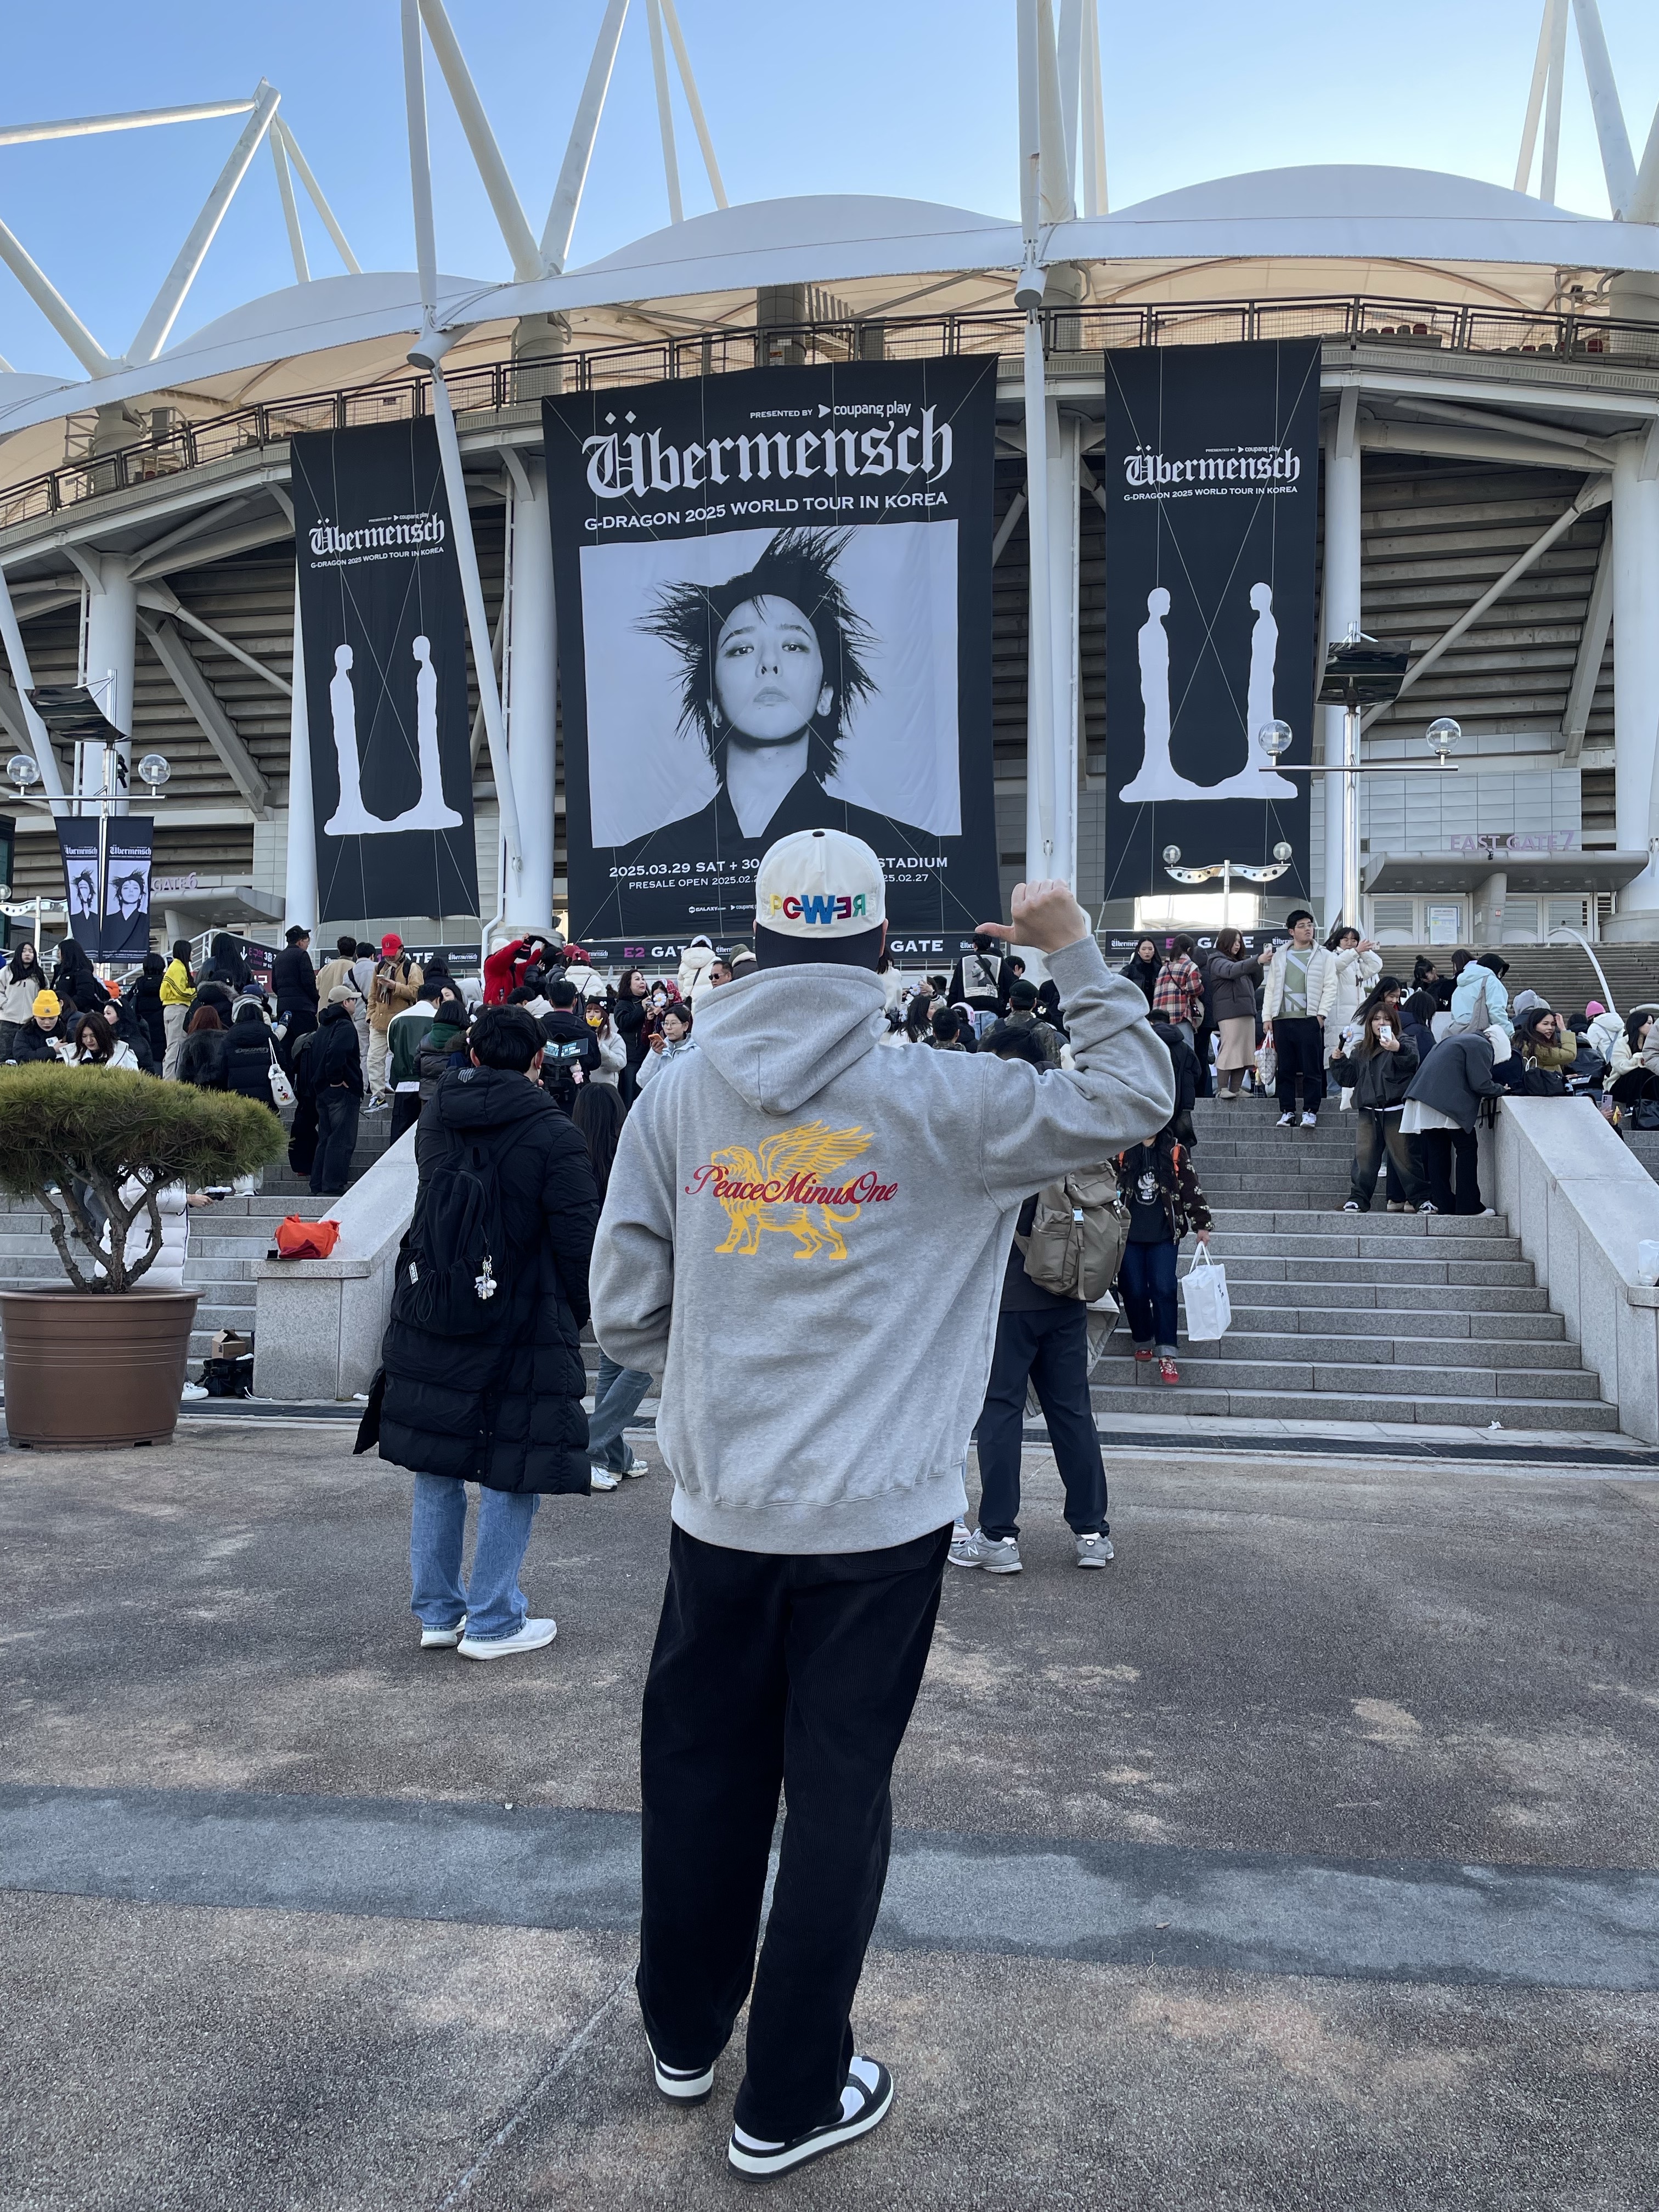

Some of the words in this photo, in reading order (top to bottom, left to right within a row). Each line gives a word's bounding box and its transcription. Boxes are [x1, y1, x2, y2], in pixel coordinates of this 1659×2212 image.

[750, 409, 799, 419] PRESENTED
[800, 409, 813, 417] BY
[834, 403, 884, 418] coupang
[887, 401, 912, 417] play
[582, 404, 953, 499] Übermensch
[1124, 444, 1300, 486] Übermensch
[1124, 492, 1170, 501] G-DRAGON
[584, 510, 680, 531] G-DRAGON
[685, 504, 726, 523] 2025
[730, 499, 798, 515] WORLD
[803, 496, 855, 512] TOUR
[860, 495, 881, 509] IN
[885, 492, 948, 508] KOREA
[308, 512, 445, 555] Übermensch
[311, 559, 346, 568] G-DRAGON
[348, 556, 362, 565] 2025
[363, 552, 388, 561] WORLD
[1451, 835, 1500, 850] EAST
[609, 863, 691, 877] 2025.03.29
[695, 861, 725, 873] SAT
[730, 861, 737, 871] +
[742, 859, 760, 870] 30
[878, 857, 947, 868] STADIUM
[629, 879, 675, 889] PRESALE
[678, 878, 708, 887] OPEN
[712, 874, 757, 885] 2025.02.2
[883, 874, 929, 882] 25.02.27
[890, 940, 943, 952] GATE
[1166, 938, 1175, 949] E
[624, 947, 645, 958] E2
[651, 945, 687, 957] GAT
[685, 1165, 898, 1204] PeaceMinusOne
